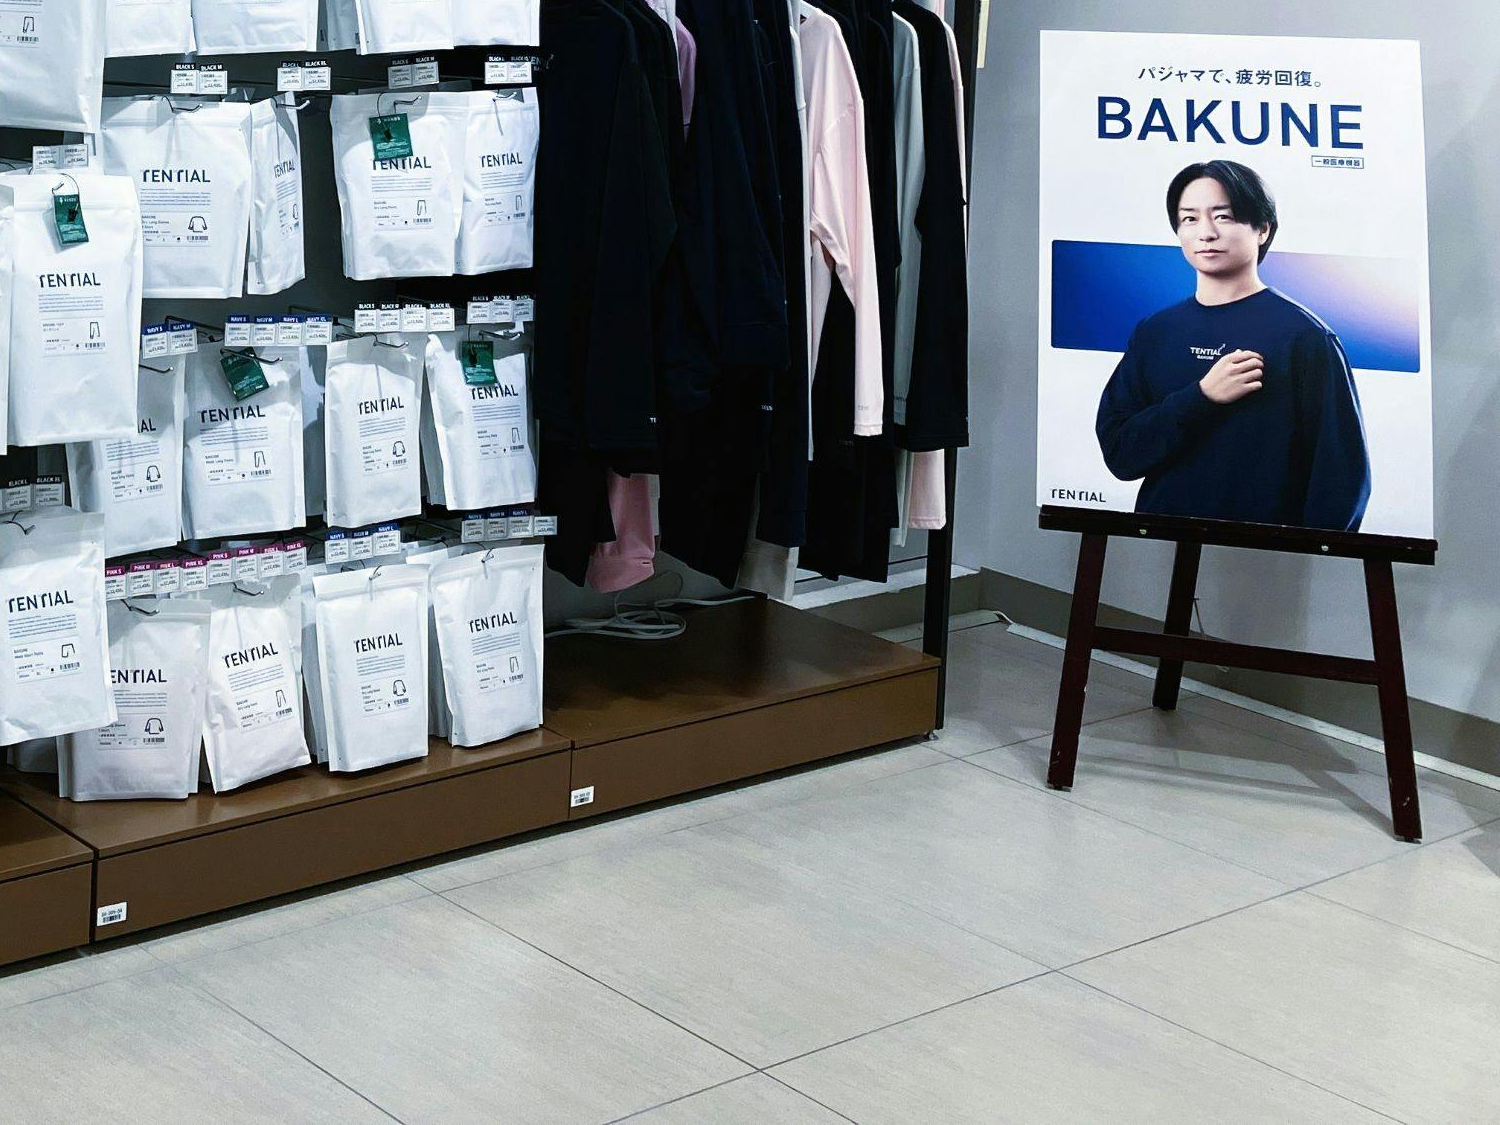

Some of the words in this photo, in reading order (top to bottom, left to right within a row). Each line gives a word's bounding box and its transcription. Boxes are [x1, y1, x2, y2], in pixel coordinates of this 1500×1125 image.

[1138, 65, 1322, 89] パジャマで、疲労回復。
[1097, 96, 1364, 150] BAKUNE
[482, 153, 522, 167] TENTIAL
[143, 170, 210, 182] TENTIAL
[40, 273, 100, 288] TENTIAL
[1190, 347, 1221, 356] TENTIAL
[472, 385, 518, 399] TENTIAL
[201, 404, 266, 424] TENTIAL
[359, 397, 404, 414] TENTIAL
[1051, 488, 1106, 503] TENTIAL
[9, 590, 73, 612] TENTIAL
[470, 612, 517, 633] TENTIAL
[356, 633, 402, 652] TENTIAL
[225, 643, 278, 668] TENTIAL
[111, 668, 167, 684] ENTIAL
